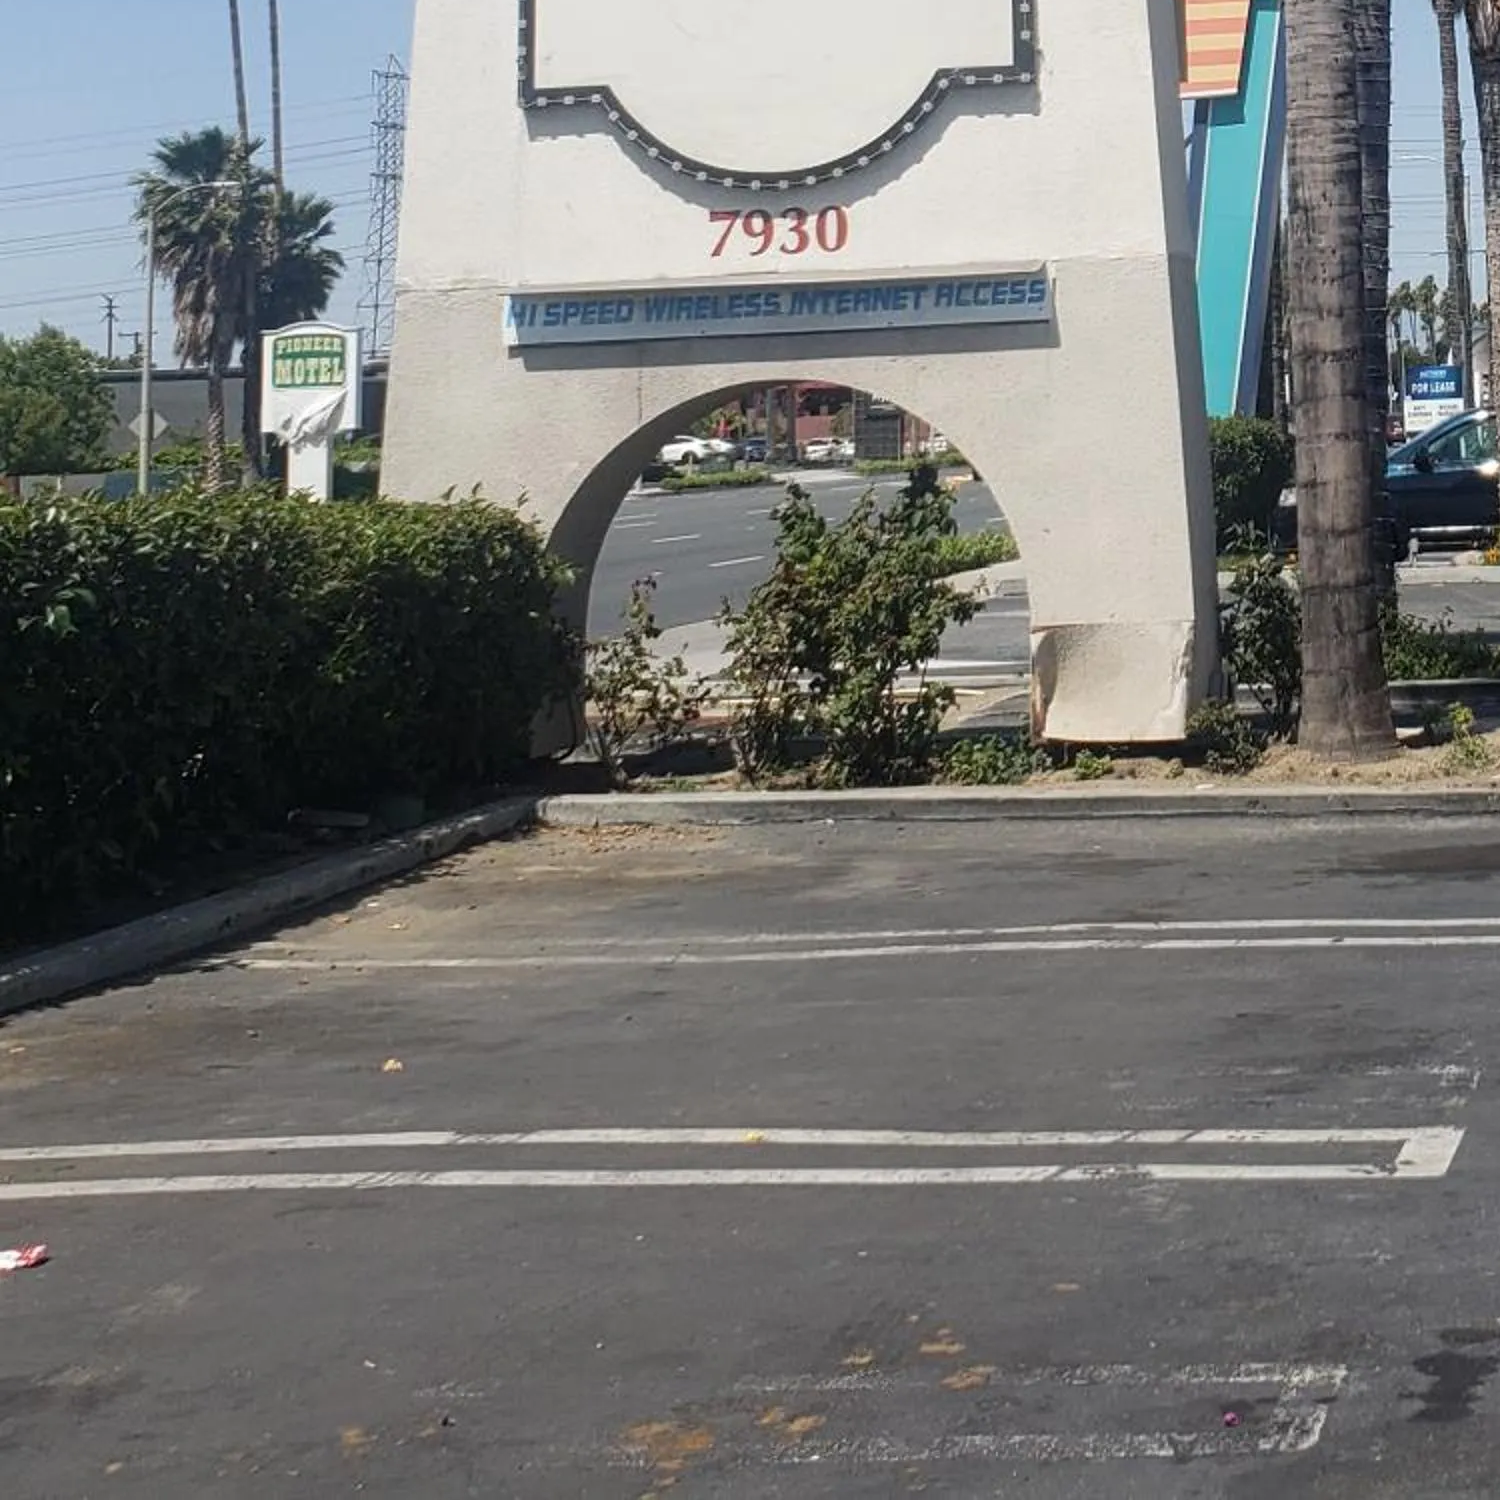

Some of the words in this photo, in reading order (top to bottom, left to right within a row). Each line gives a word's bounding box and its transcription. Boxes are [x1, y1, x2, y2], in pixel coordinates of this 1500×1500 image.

[709, 205, 848, 257] 7930
[506, 300, 538, 328] HI
[542, 298, 634, 327] SPEED
[643, 291, 784, 324] WIRELESS
[789, 285, 929, 316] INTERNET
[933, 279, 1046, 308] ACCESS
[276, 336, 343, 355] PIONEER
[275, 356, 345, 385] MOTEL
[1411, 383, 1429, 394] FOR
